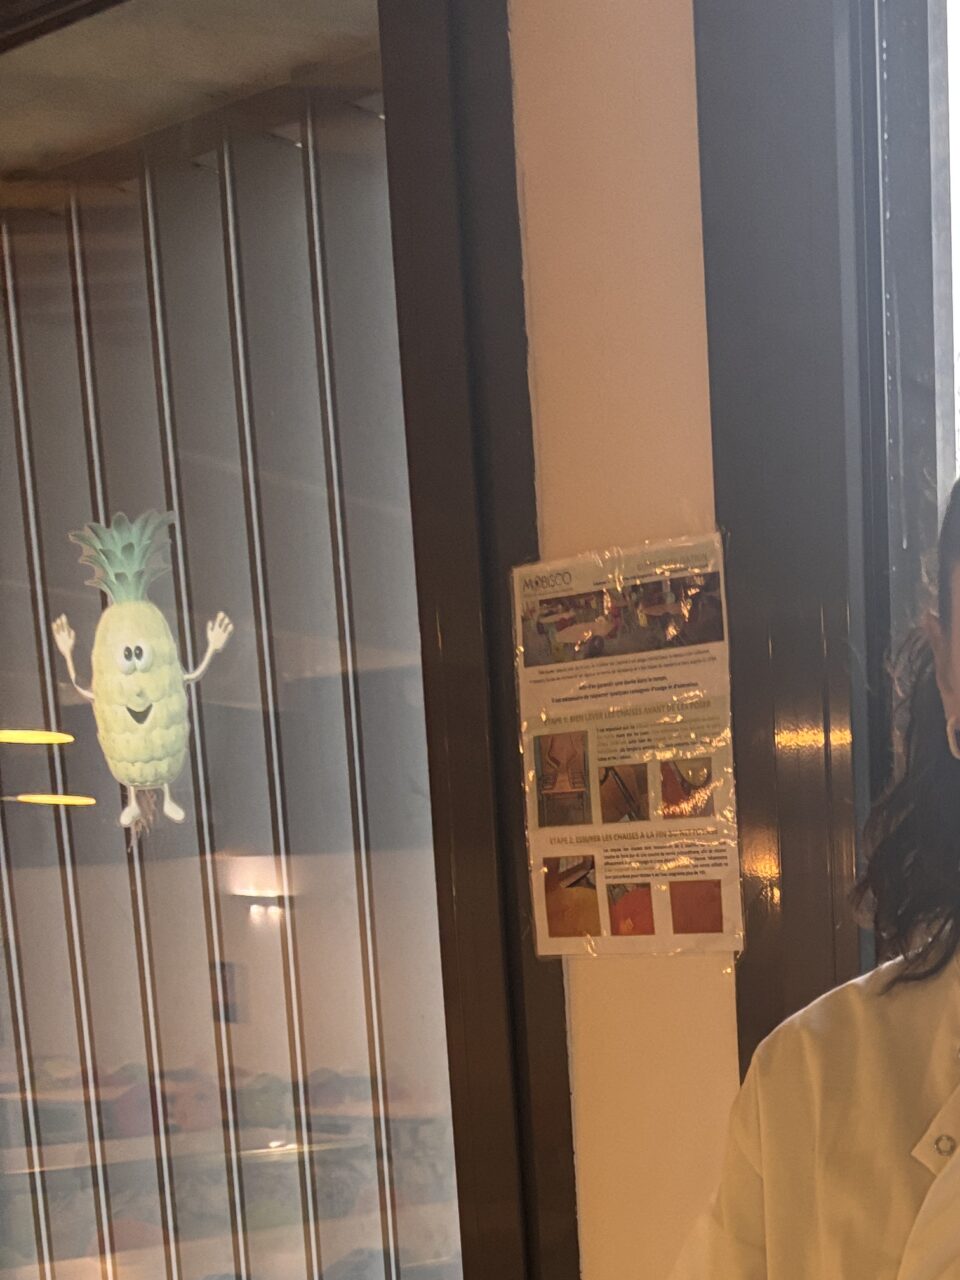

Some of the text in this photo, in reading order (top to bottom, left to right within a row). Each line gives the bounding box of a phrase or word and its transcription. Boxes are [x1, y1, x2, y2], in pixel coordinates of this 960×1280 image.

[644, 704, 665, 714] AVANT
[602, 833, 612, 842] LES
[613, 831, 639, 841] CHAISES
